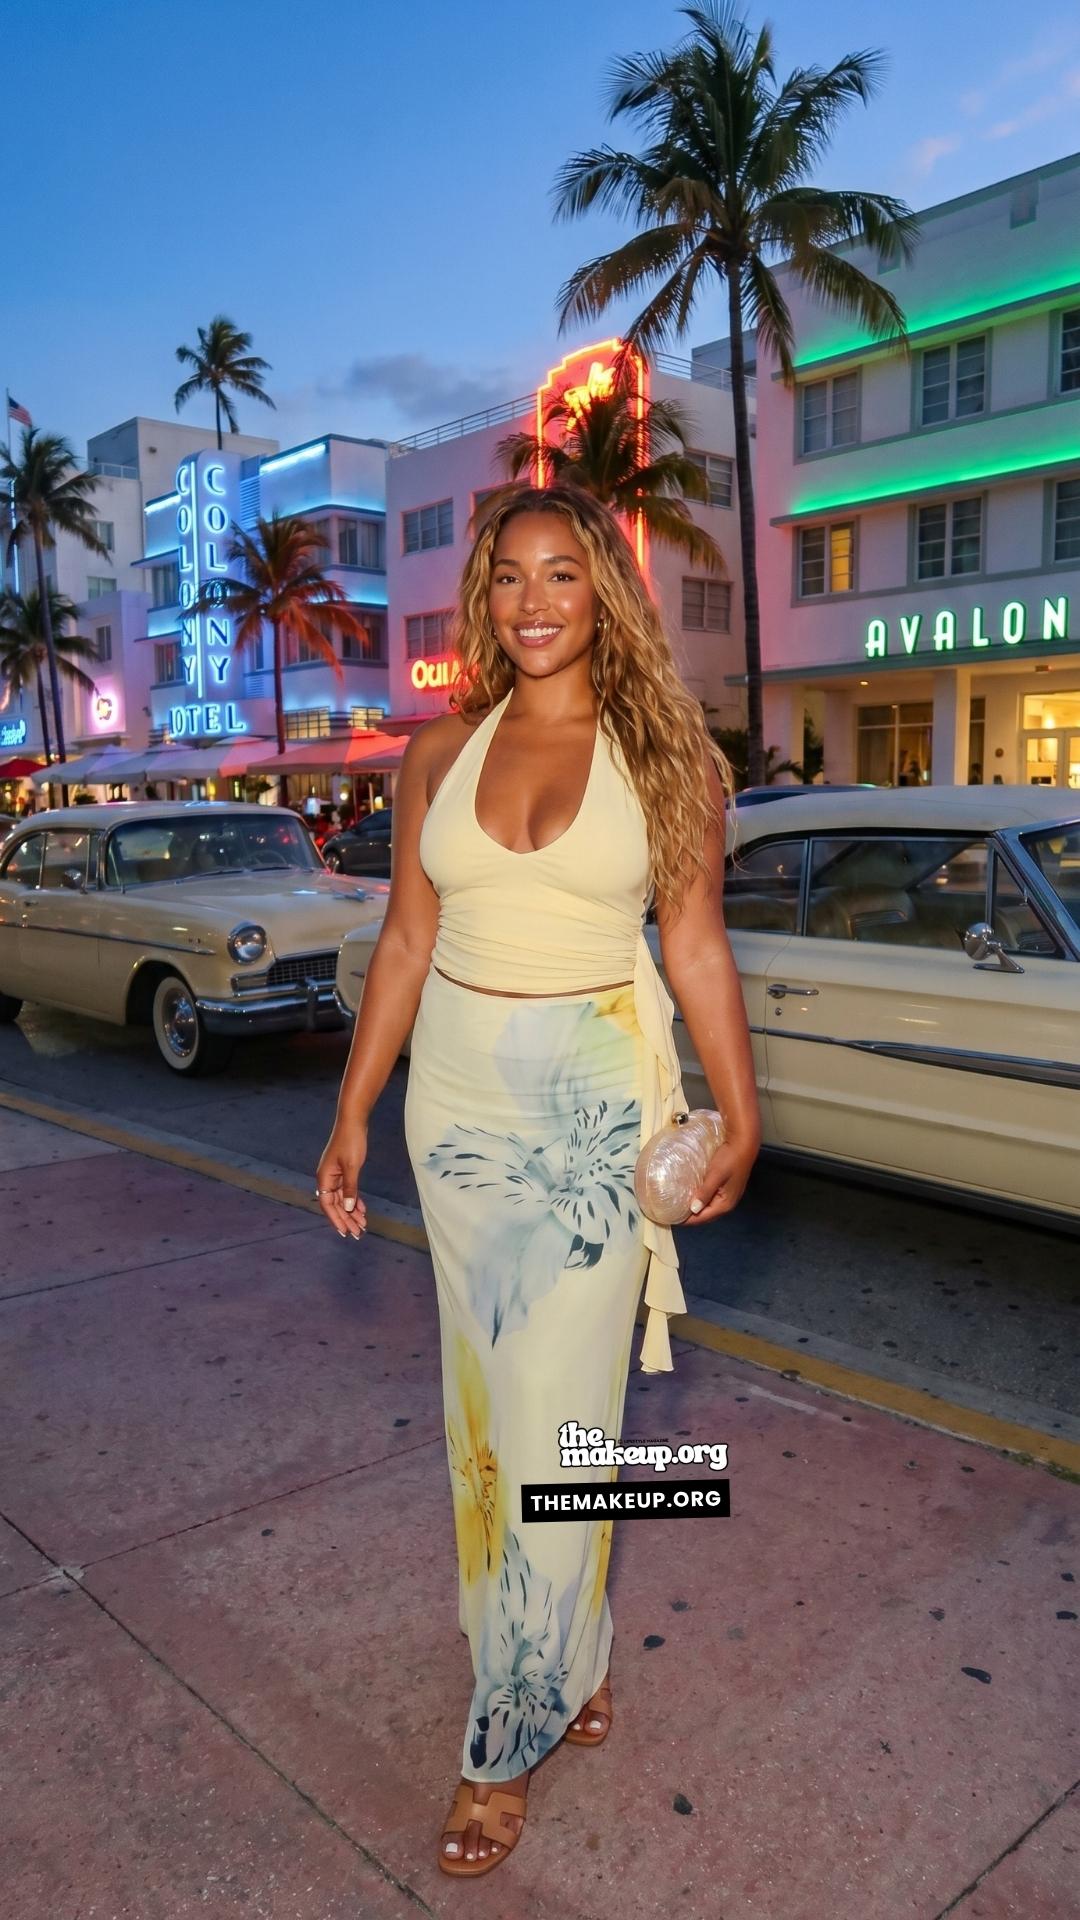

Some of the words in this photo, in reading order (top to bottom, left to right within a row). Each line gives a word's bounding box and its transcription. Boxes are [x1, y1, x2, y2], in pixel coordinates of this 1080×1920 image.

[176, 465, 195, 684] COLONY
[203, 464, 232, 683] COLONY
[865, 597, 1068, 657] AVALON
